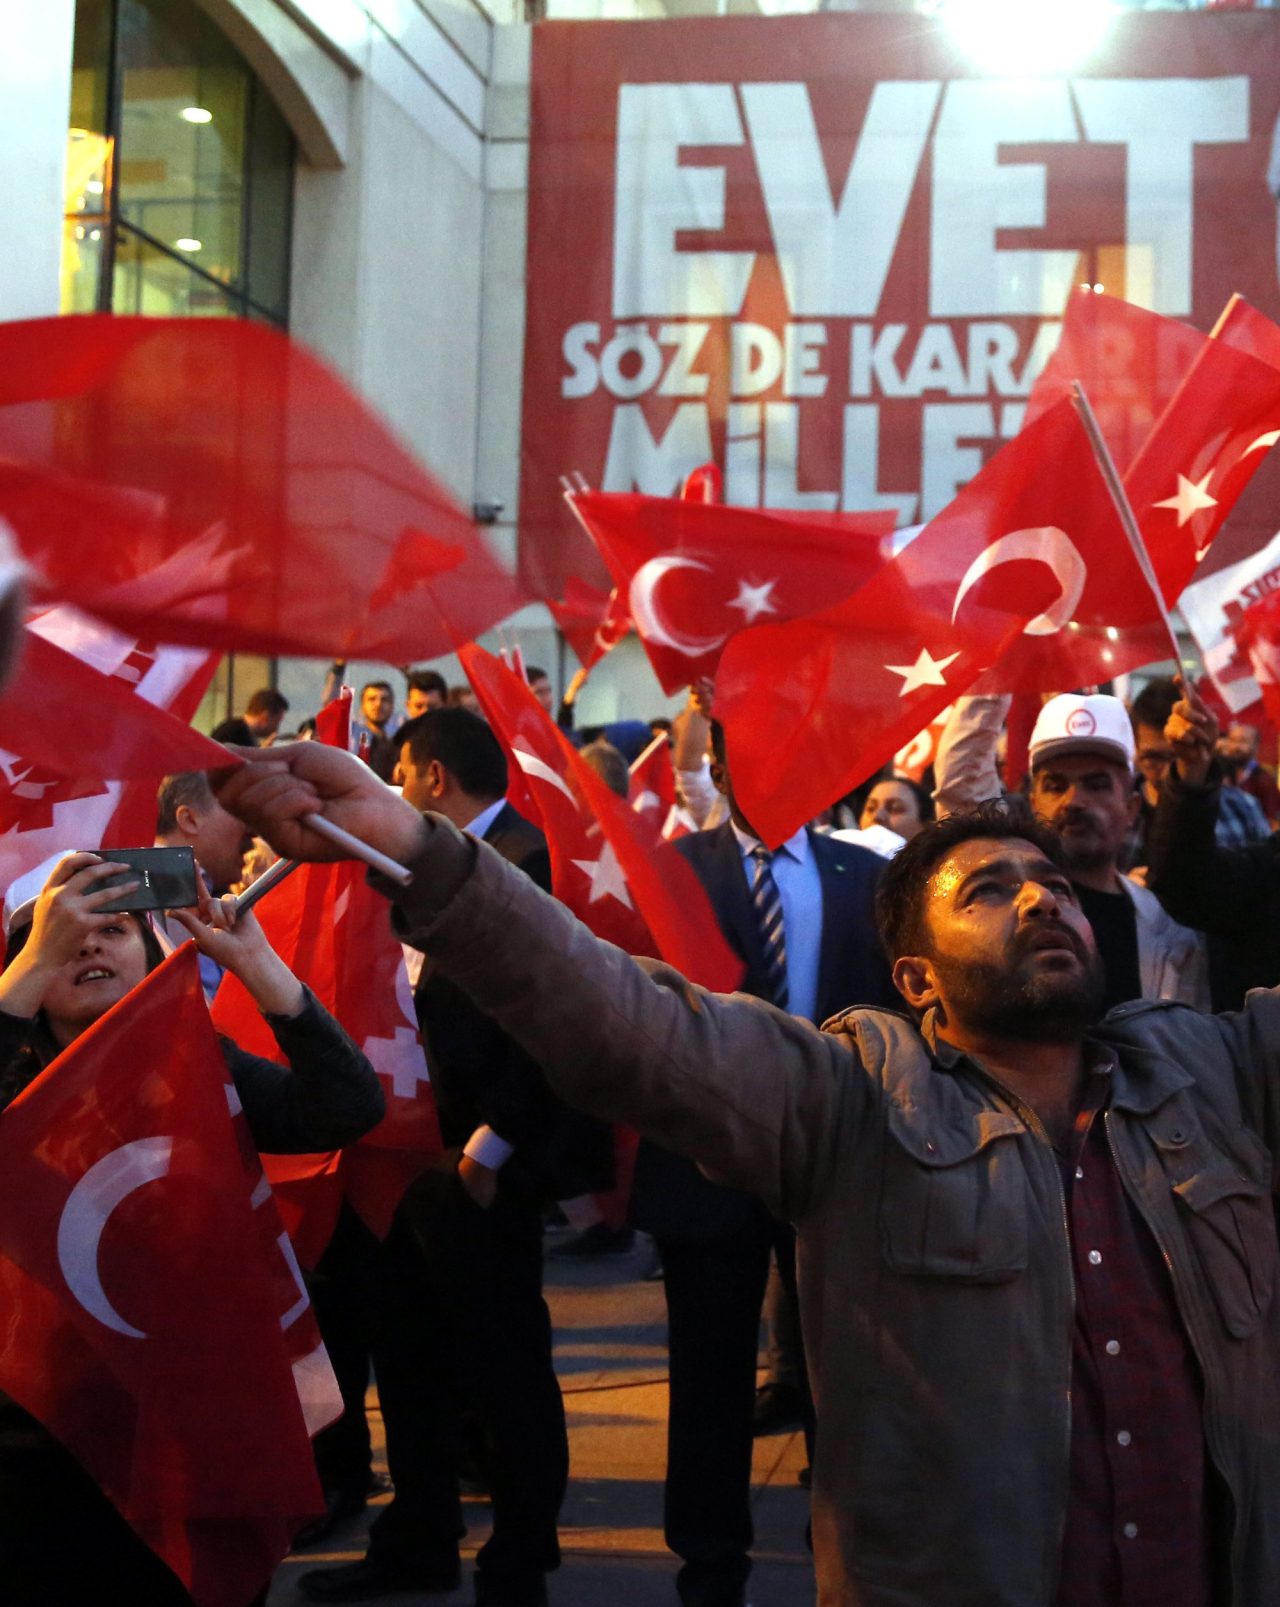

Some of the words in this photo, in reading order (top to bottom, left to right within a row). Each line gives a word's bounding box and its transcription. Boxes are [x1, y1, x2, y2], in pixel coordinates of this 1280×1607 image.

[612, 76, 1250, 318] EVET
[562, 322, 710, 398] SÖZ
[731, 322, 830, 398] DE
